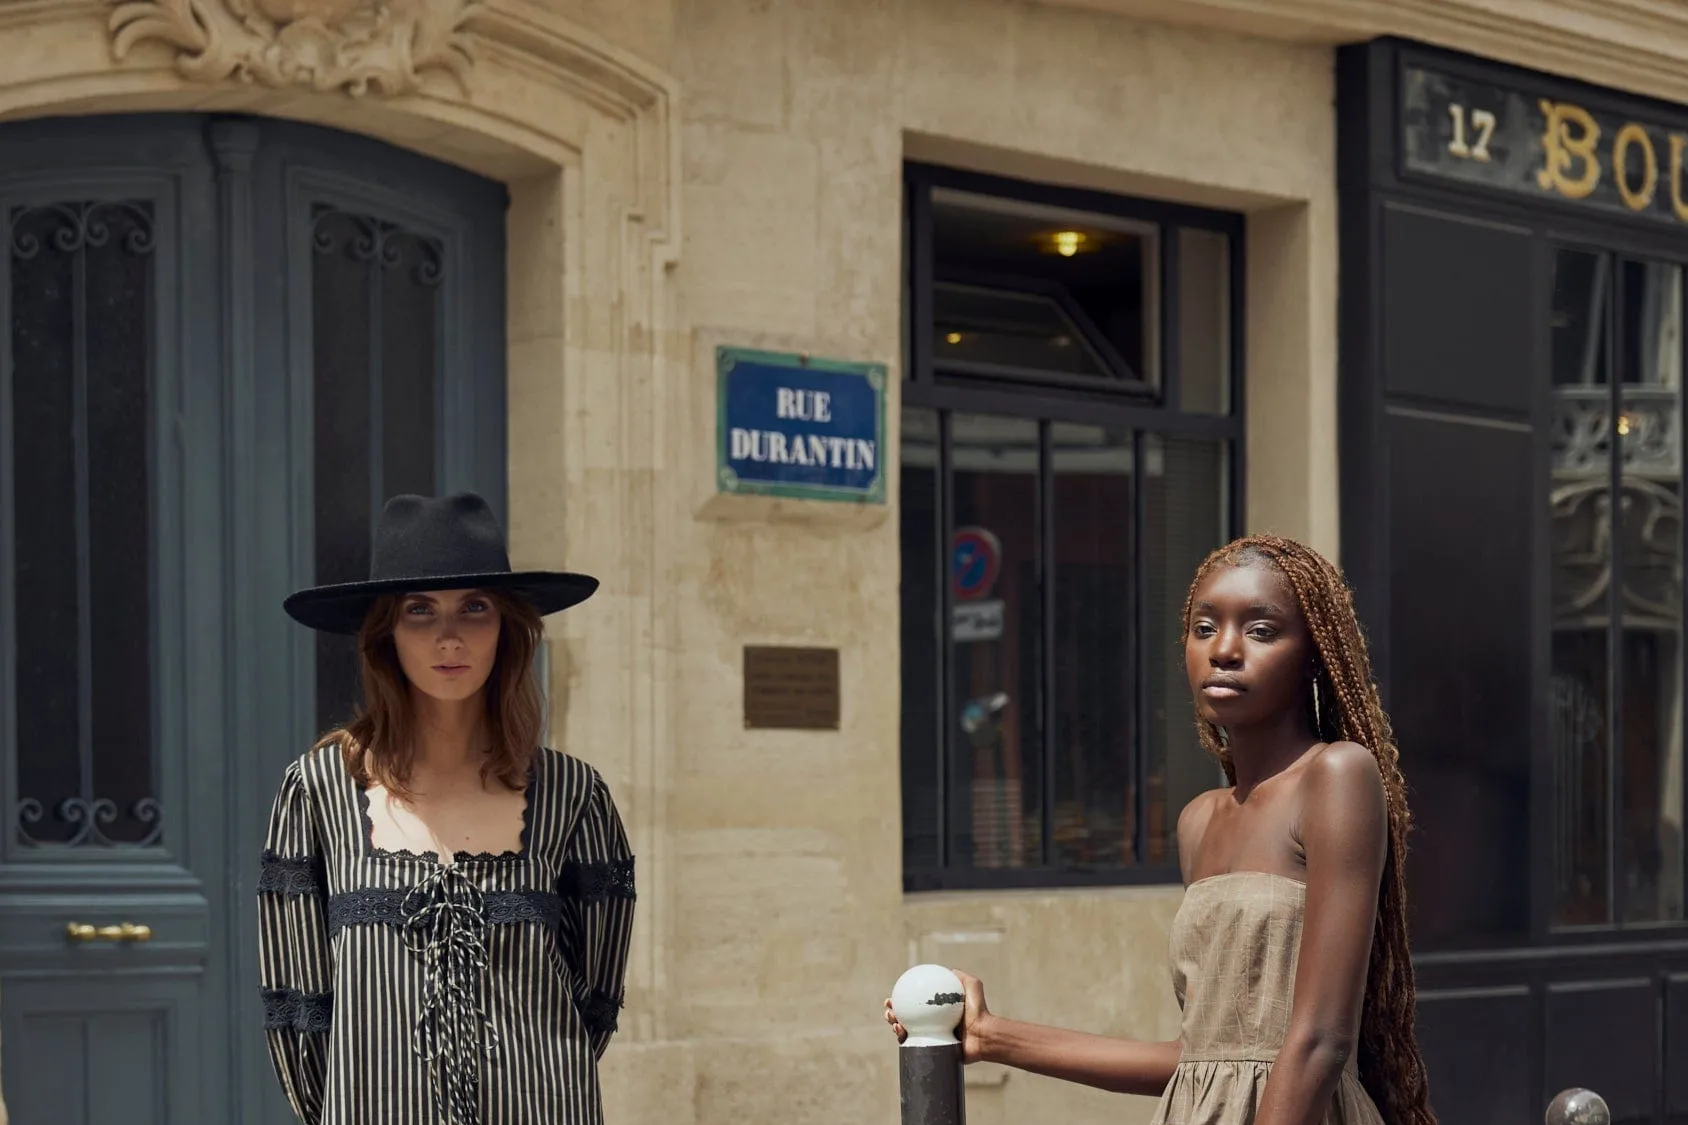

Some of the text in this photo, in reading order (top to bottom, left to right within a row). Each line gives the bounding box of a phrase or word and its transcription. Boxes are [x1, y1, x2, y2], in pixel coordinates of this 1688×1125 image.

[1448, 103, 1497, 162] 17
[776, 387, 831, 422] RUE
[731, 427, 875, 470] DURANTIN
